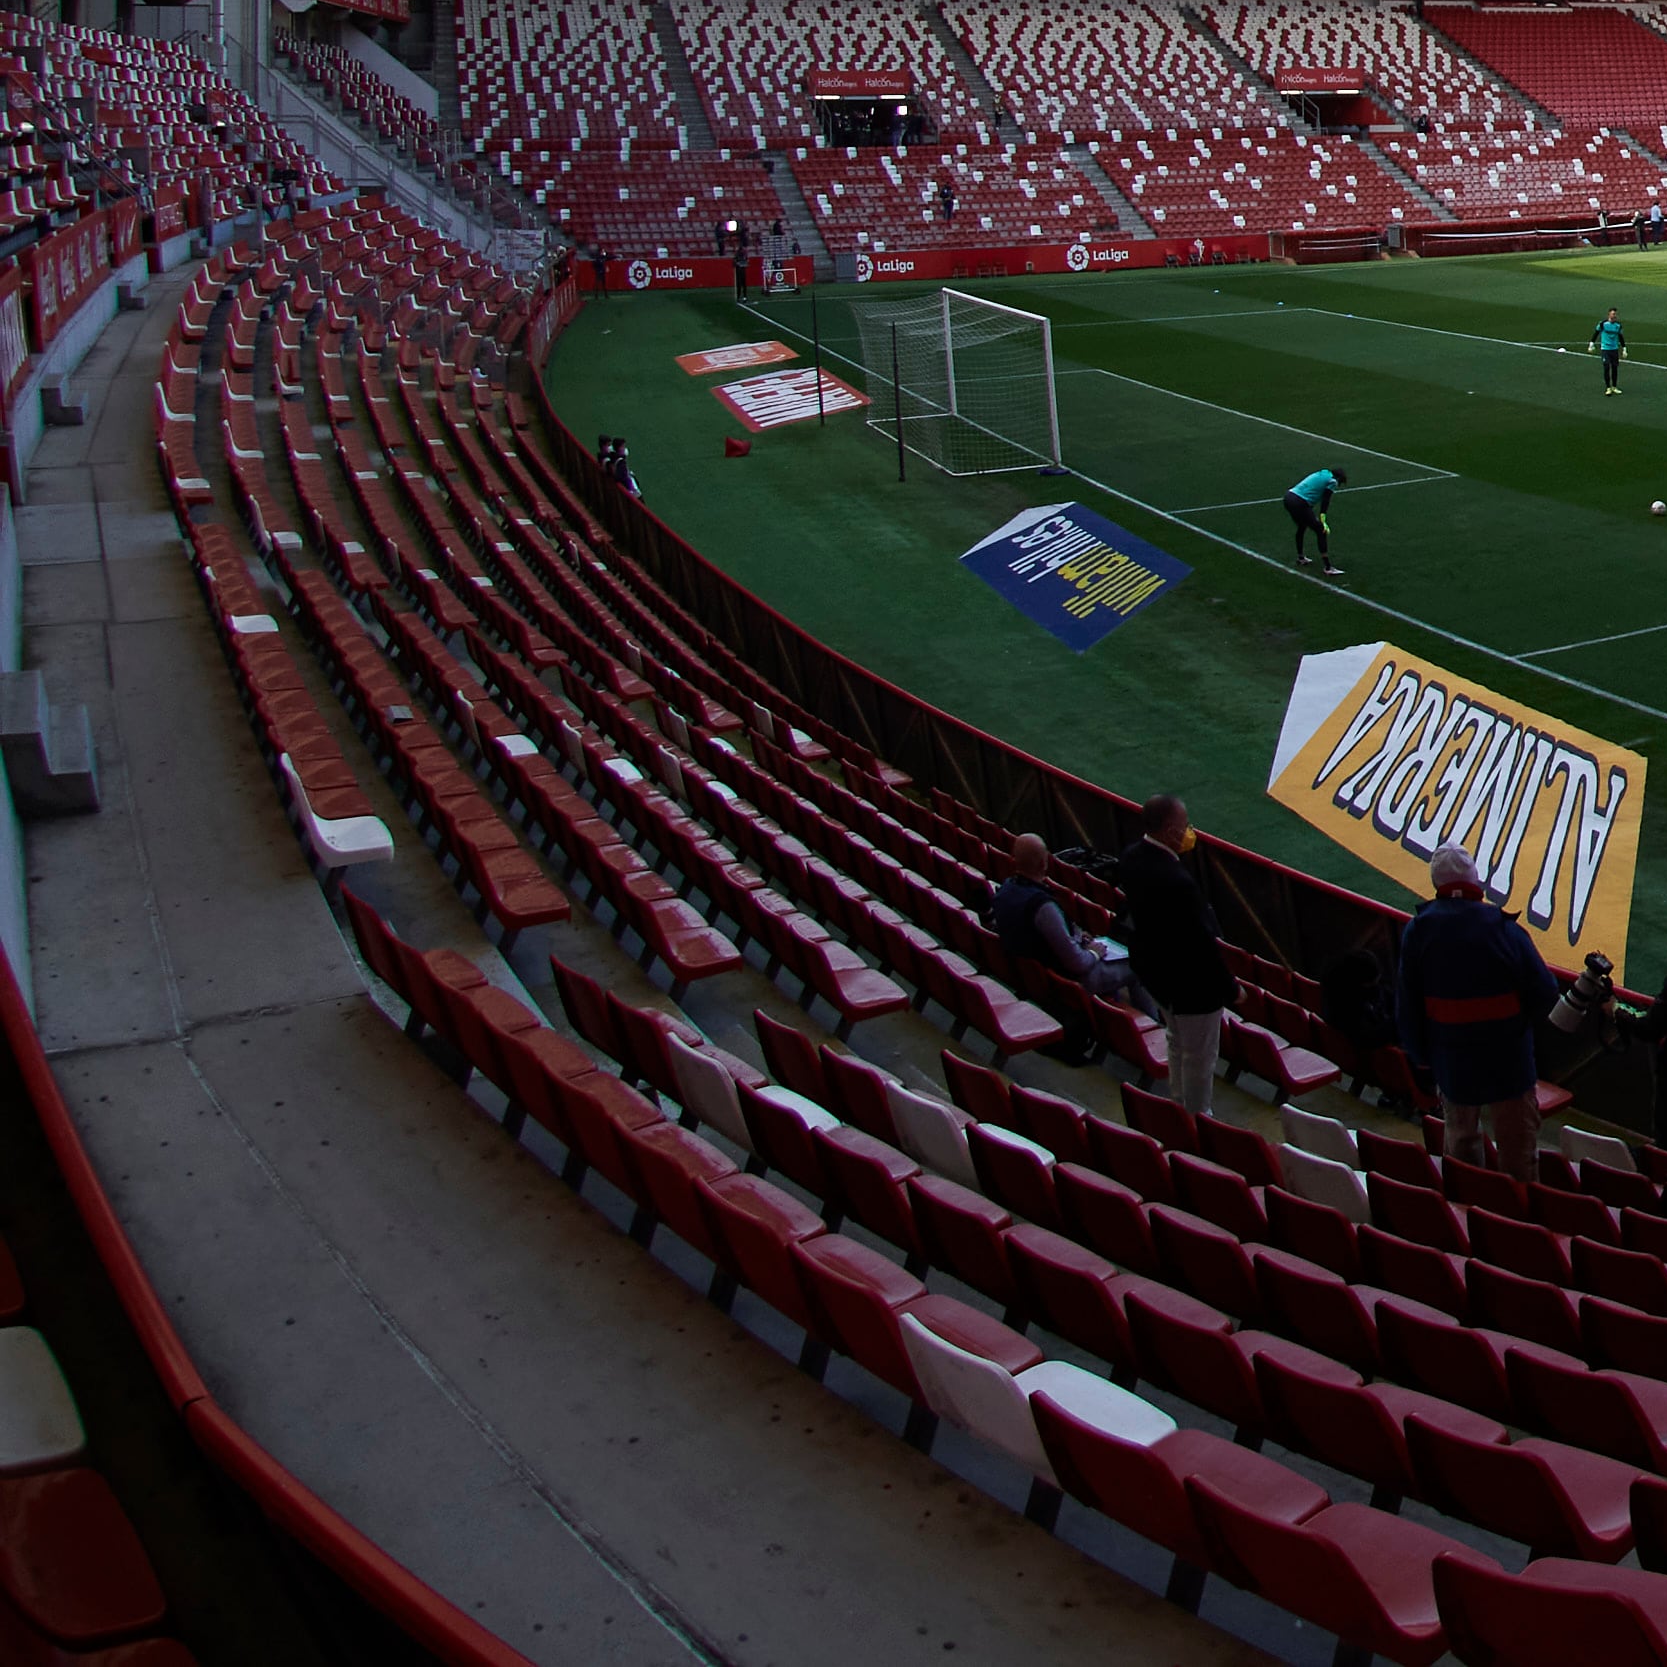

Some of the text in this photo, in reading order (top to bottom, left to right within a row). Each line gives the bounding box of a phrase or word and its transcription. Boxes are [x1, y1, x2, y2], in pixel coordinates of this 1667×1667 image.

[1093, 248, 1128, 261] LaLiga
[877, 259, 914, 272] LaLiga
[656, 266, 693, 280] LaLiga
[1007, 515, 1167, 619] williamhill.es
[1312, 660, 1627, 947] ALIMERKA
